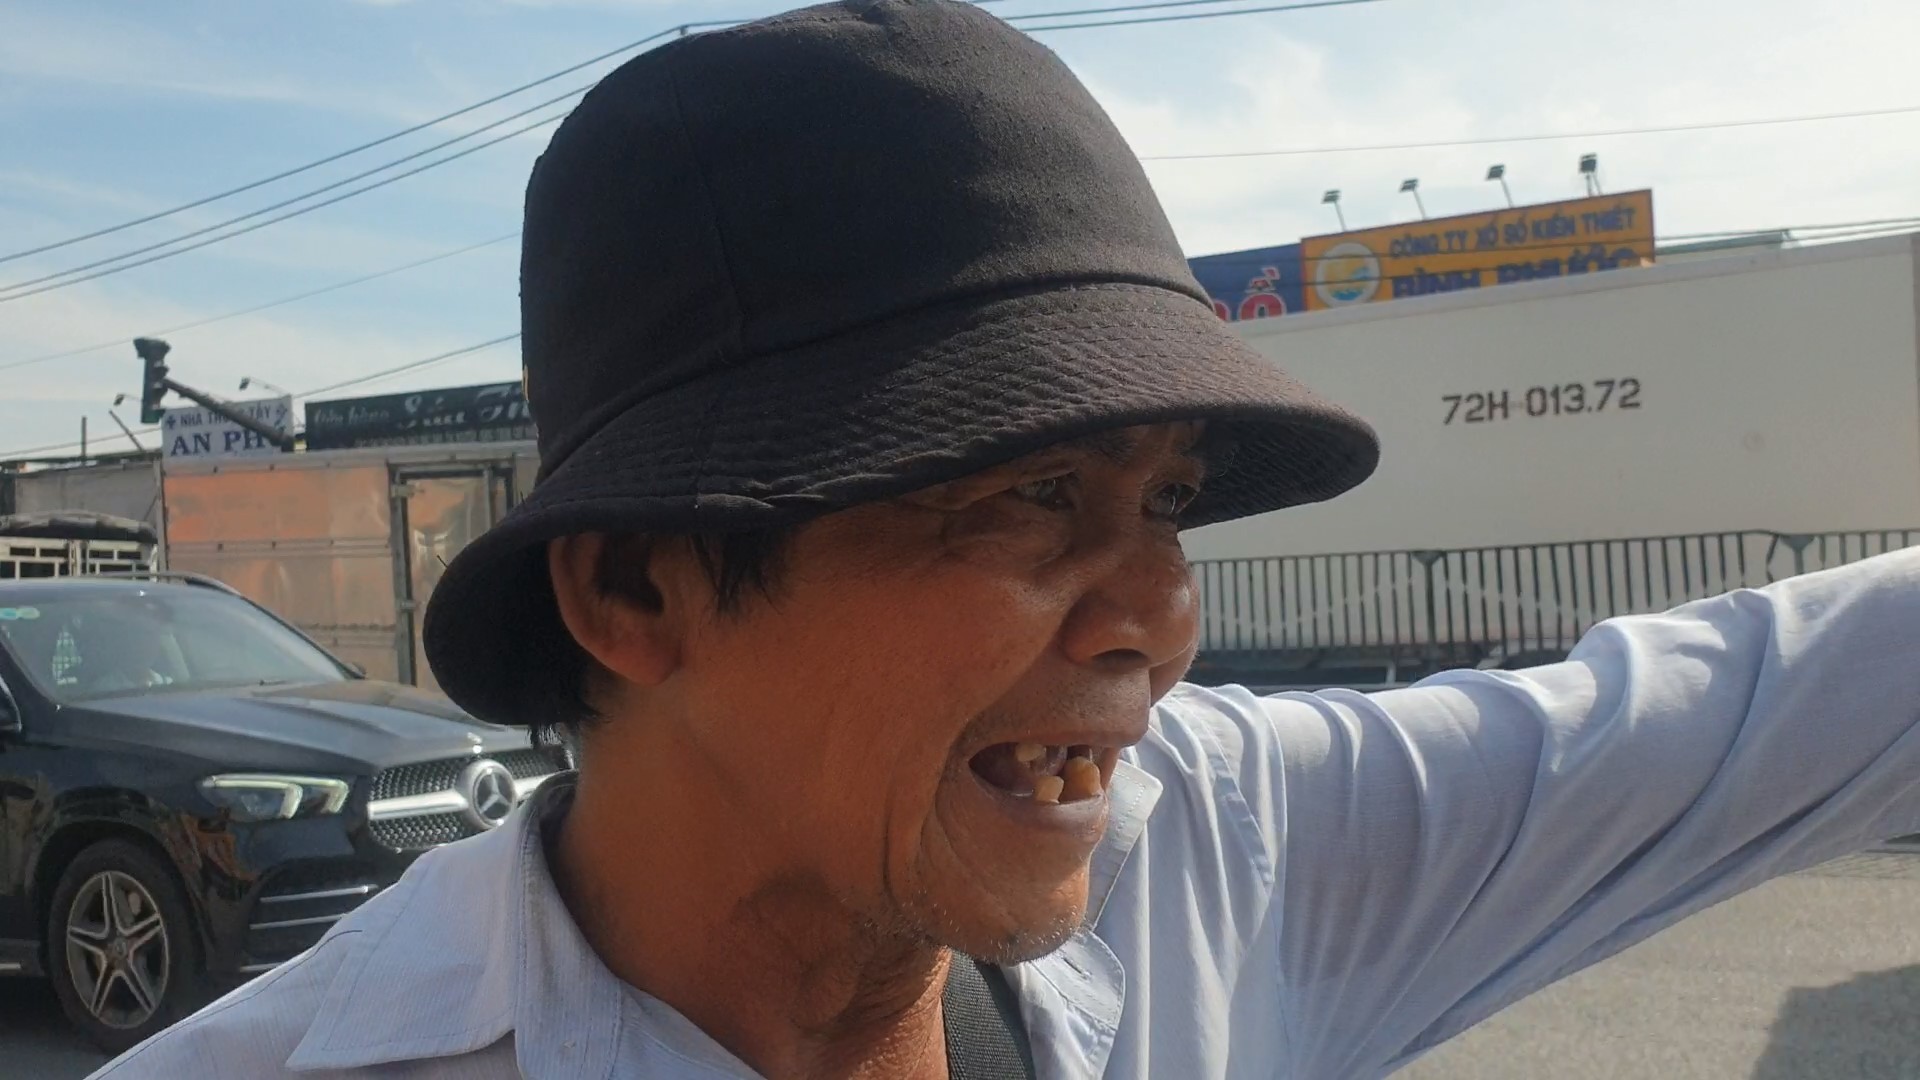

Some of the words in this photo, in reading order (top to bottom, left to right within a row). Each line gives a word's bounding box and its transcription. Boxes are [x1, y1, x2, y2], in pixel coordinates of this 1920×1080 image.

[1444, 229, 1469, 252] TY
[170, 432, 211, 456] AN
[222, 427, 276, 452] PH
